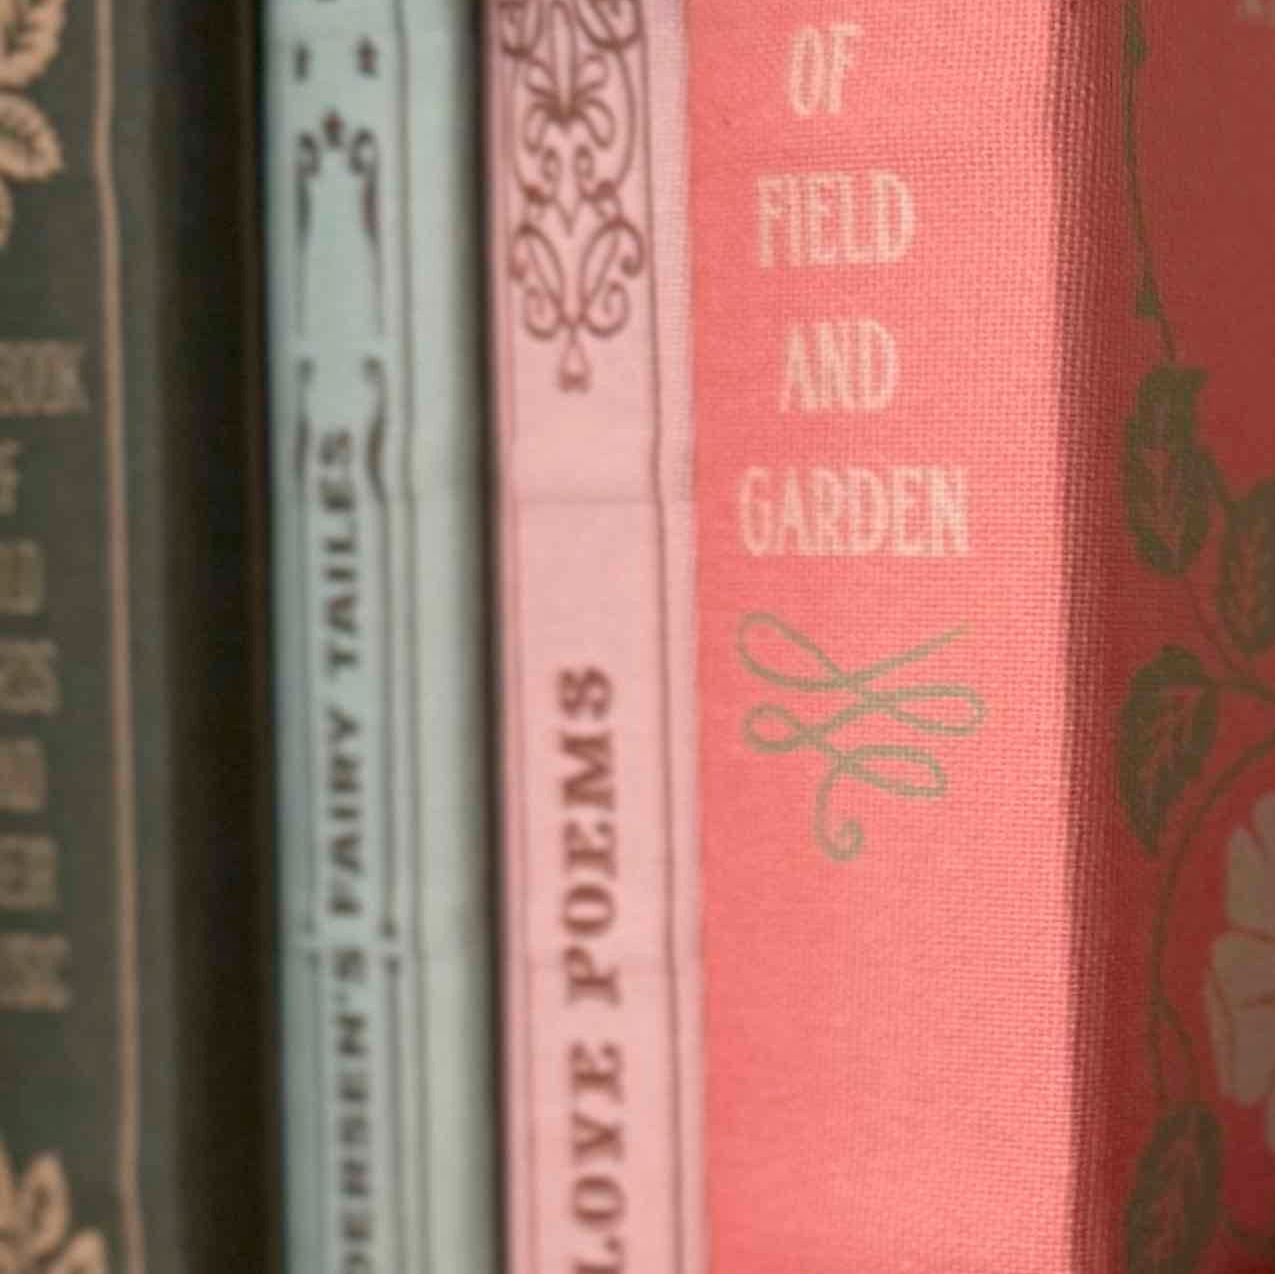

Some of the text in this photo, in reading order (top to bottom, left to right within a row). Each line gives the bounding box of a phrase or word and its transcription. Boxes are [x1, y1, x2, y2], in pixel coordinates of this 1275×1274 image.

[789, 20, 864, 116] OF
[753, 168, 917, 270] FIELD
[778, 319, 898, 415] AND
[737, 463, 970, 558] GARDEN
[324, 704, 364, 919] FAIRY
[556, 665, 621, 1008] POEMS
